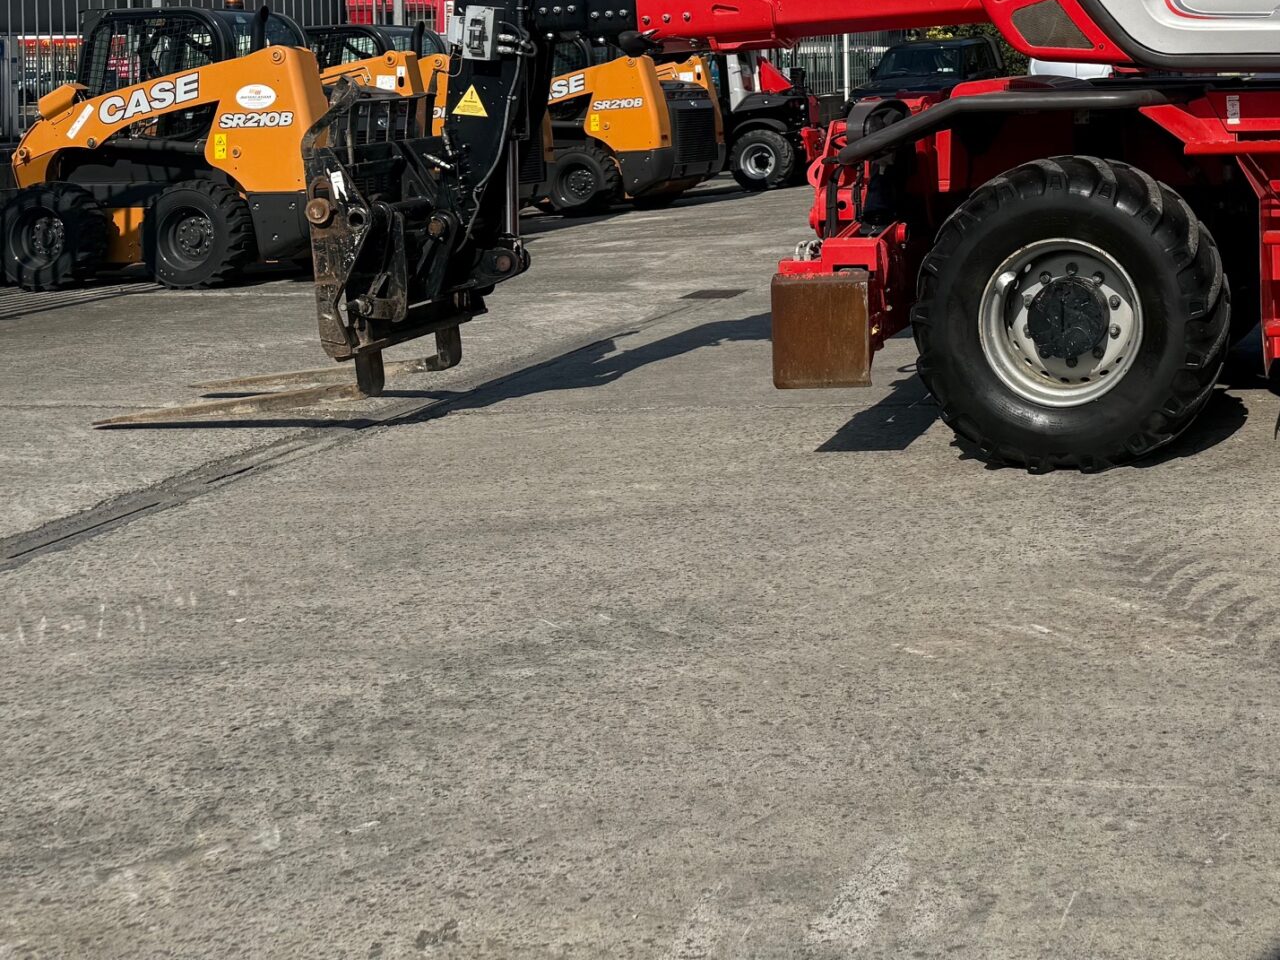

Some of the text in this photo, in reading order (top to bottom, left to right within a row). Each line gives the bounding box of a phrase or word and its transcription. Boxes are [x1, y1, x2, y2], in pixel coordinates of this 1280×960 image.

[98, 72, 200, 124] CASE
[592, 97, 643, 111] SR210B
[219, 111, 294, 129] SR210B
